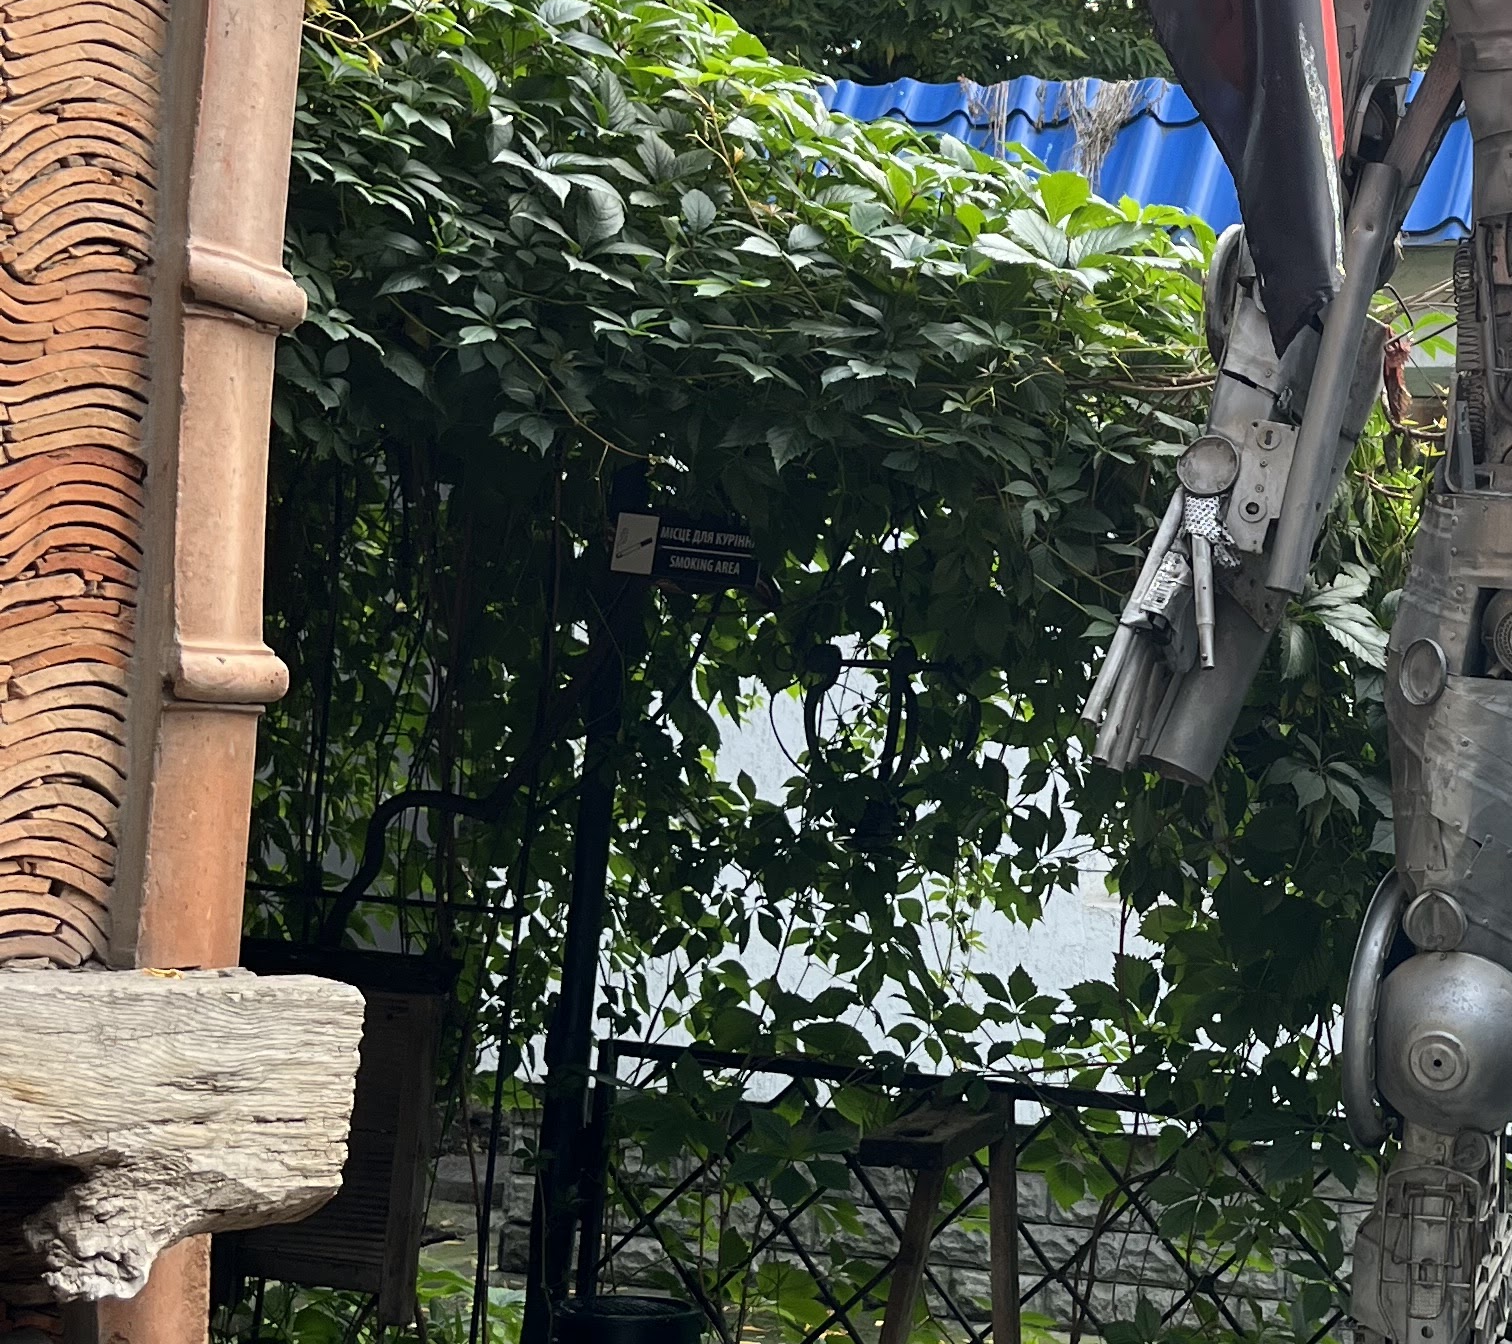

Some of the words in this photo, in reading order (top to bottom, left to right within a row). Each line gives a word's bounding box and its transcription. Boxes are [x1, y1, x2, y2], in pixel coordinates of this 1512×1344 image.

[660, 526, 692, 543] МІСЦЕ
[692, 529, 714, 544] ДЛЯ
[715, 533, 755, 548] КУРІНН
[669, 555, 714, 572] SMOKING
[714, 561, 741, 575] AREA
